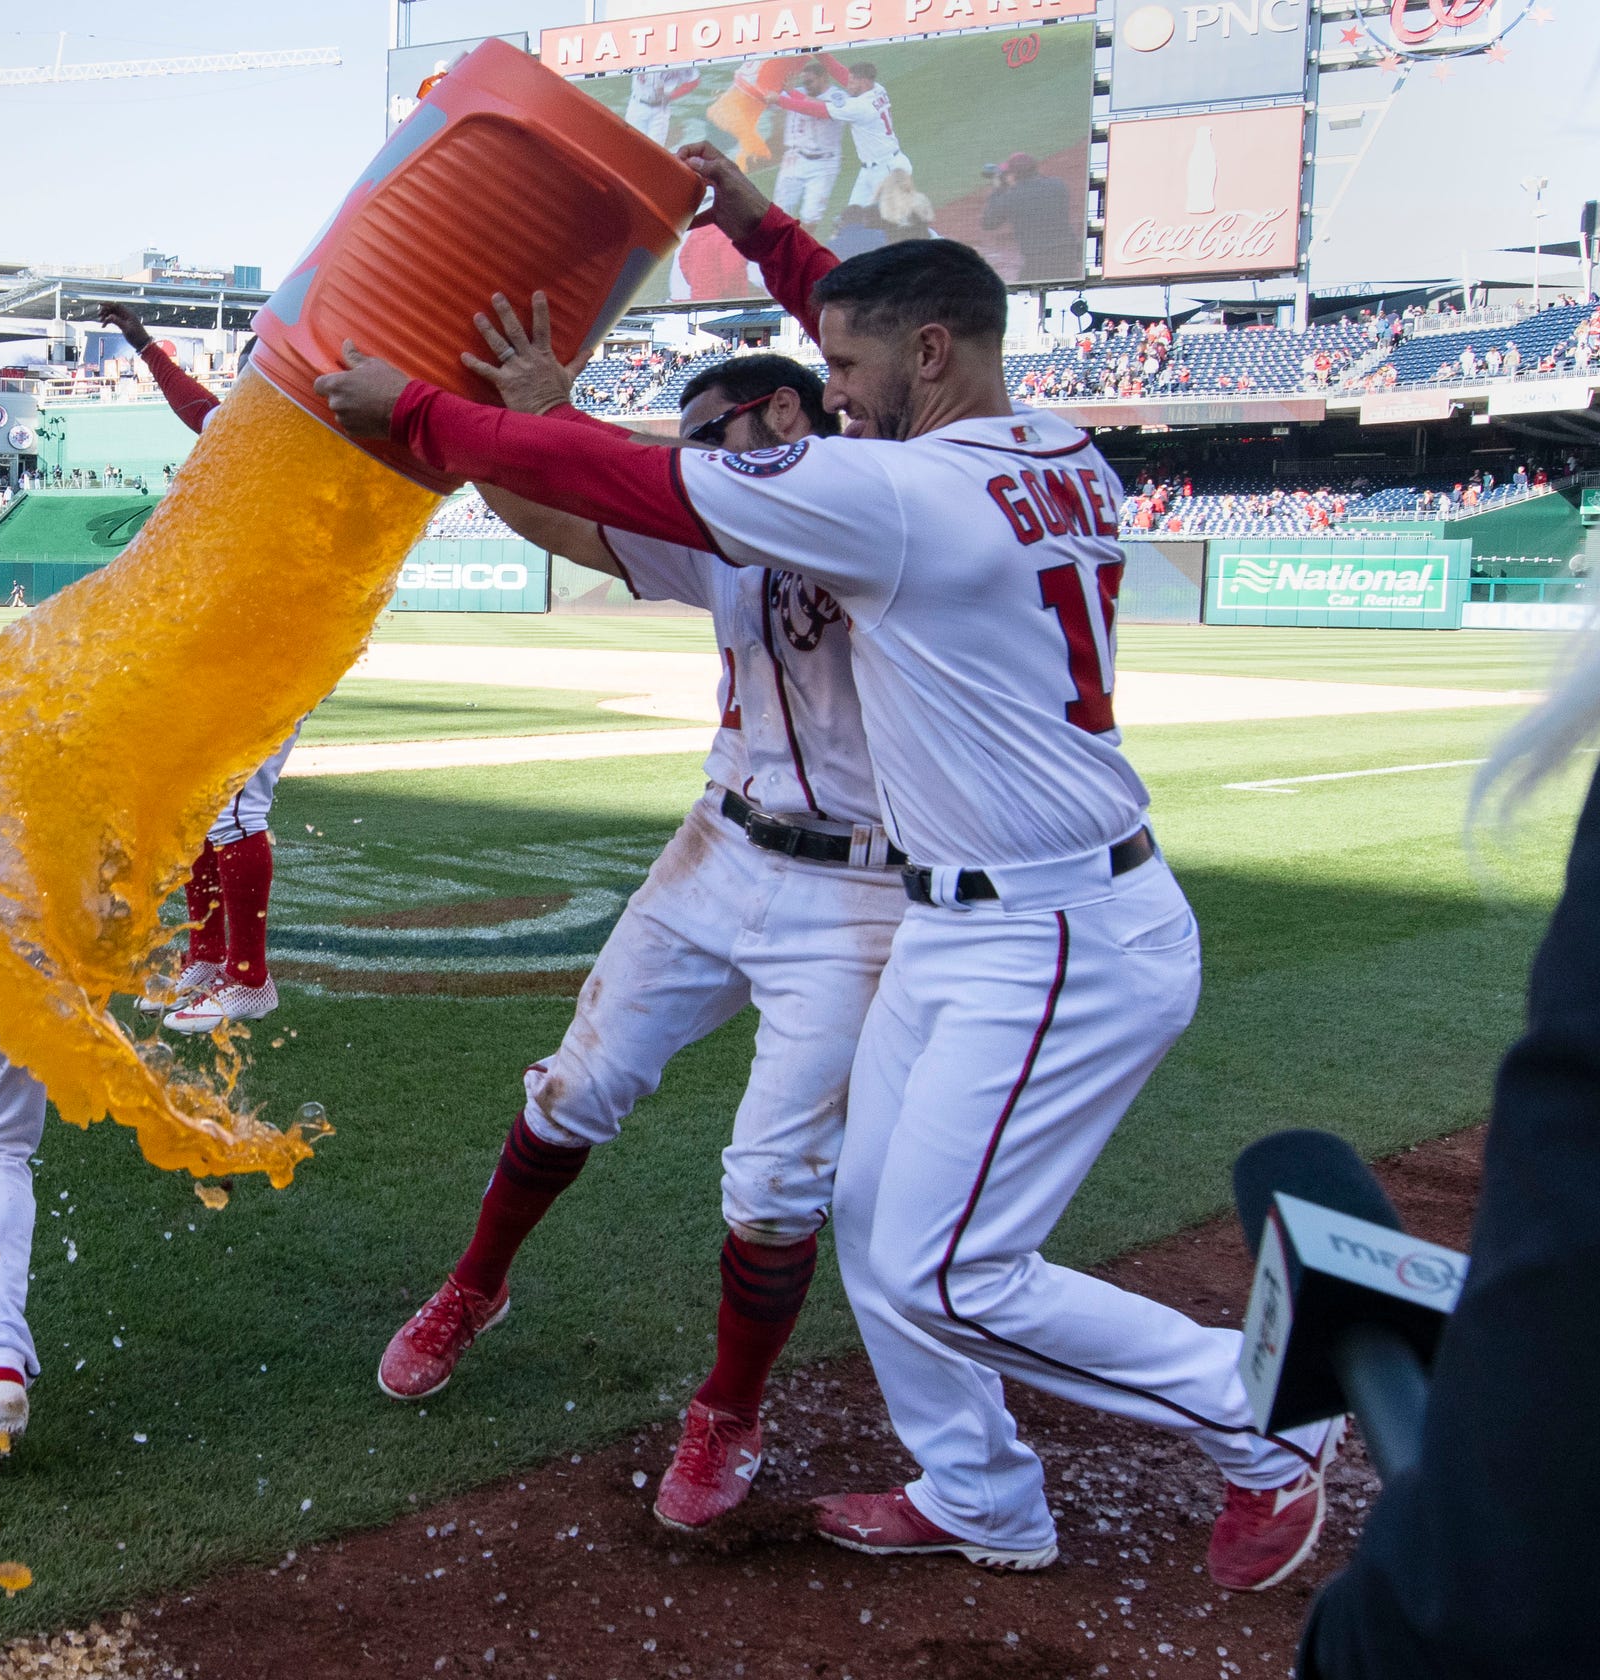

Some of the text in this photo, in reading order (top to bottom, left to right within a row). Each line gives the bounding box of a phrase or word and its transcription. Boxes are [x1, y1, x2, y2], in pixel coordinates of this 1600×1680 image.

[557, 0, 1063, 65] NATIONALS PA
[1181, 0, 1300, 42] PNC
[1115, 208, 1288, 265] Coca-Cola
[1167, 404, 1233, 421] NATS WIN
[396, 563, 528, 590] GEICO
[1327, 593, 1424, 607] Car Rental
